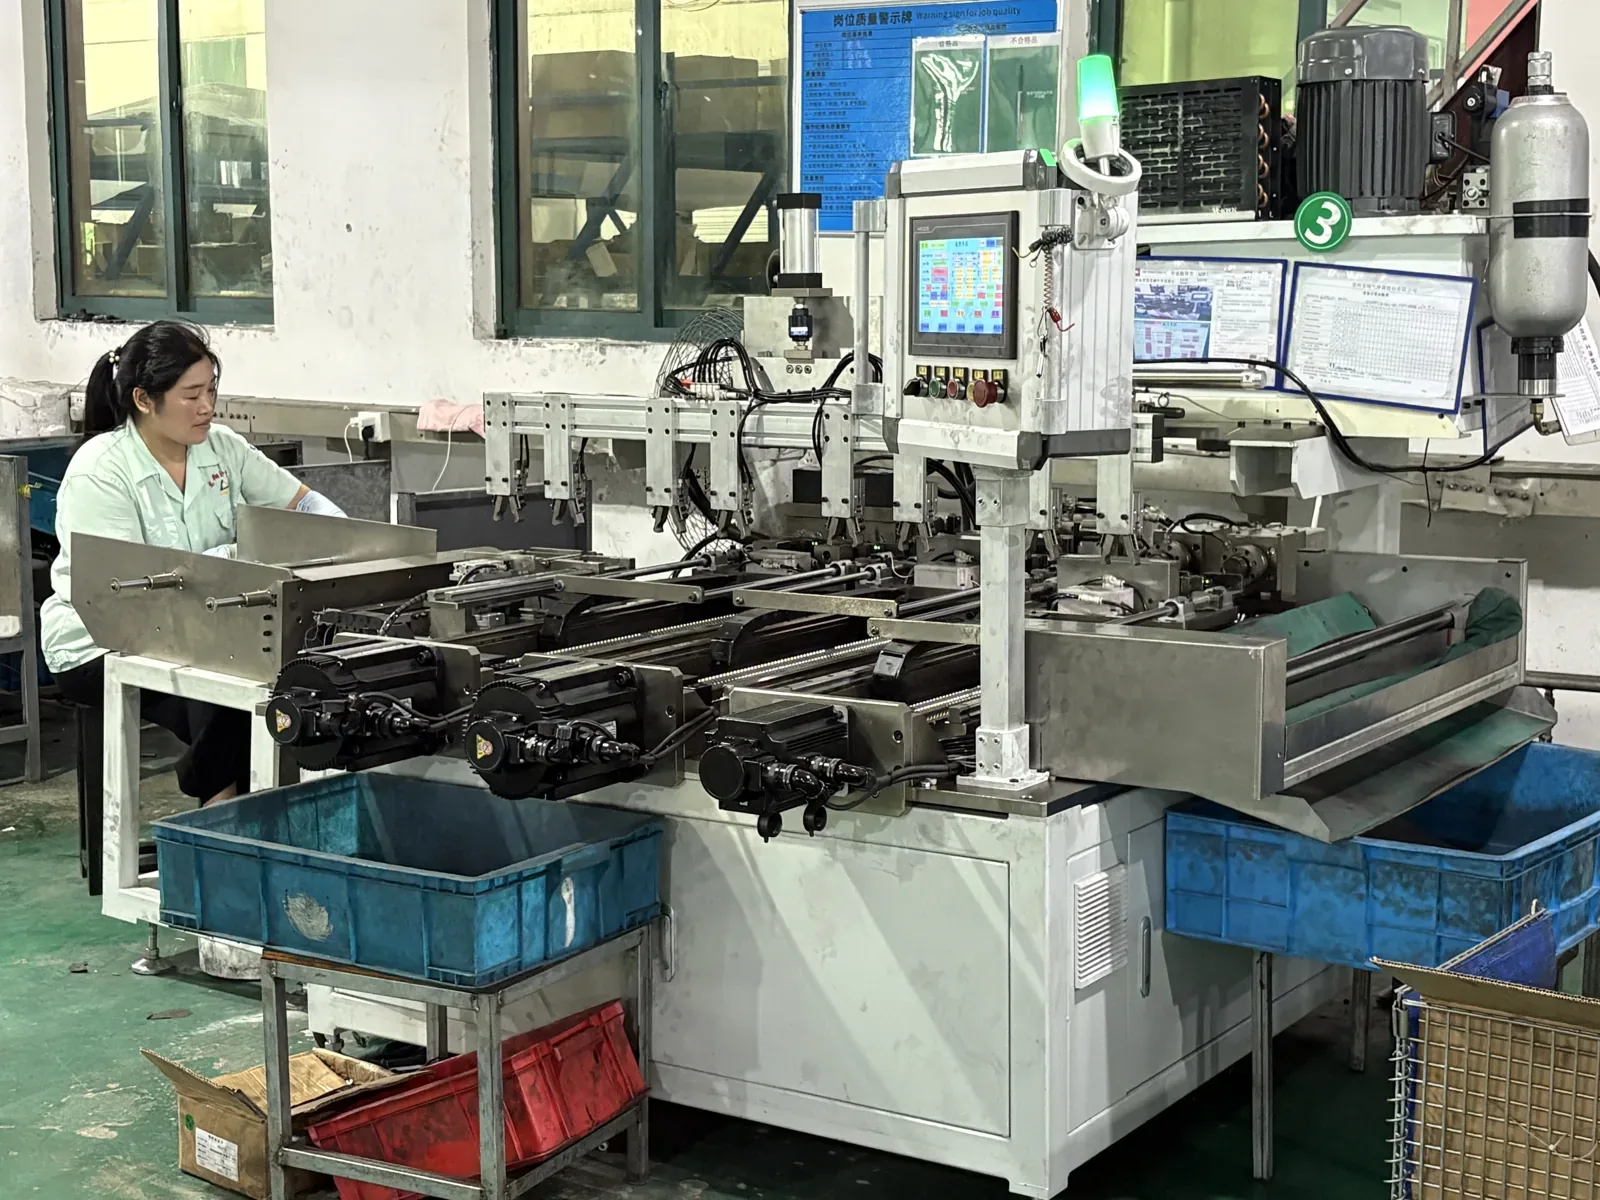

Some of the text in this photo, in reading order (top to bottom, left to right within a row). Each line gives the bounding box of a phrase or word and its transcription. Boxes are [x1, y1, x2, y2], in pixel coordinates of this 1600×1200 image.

[833, 10, 912, 27] 岗位质量警示牌
[917, 7, 1021, 20] Warning sign for job quality
[1011, 36, 1038, 45] 不合格品
[1304, 201, 1342, 244] 3
